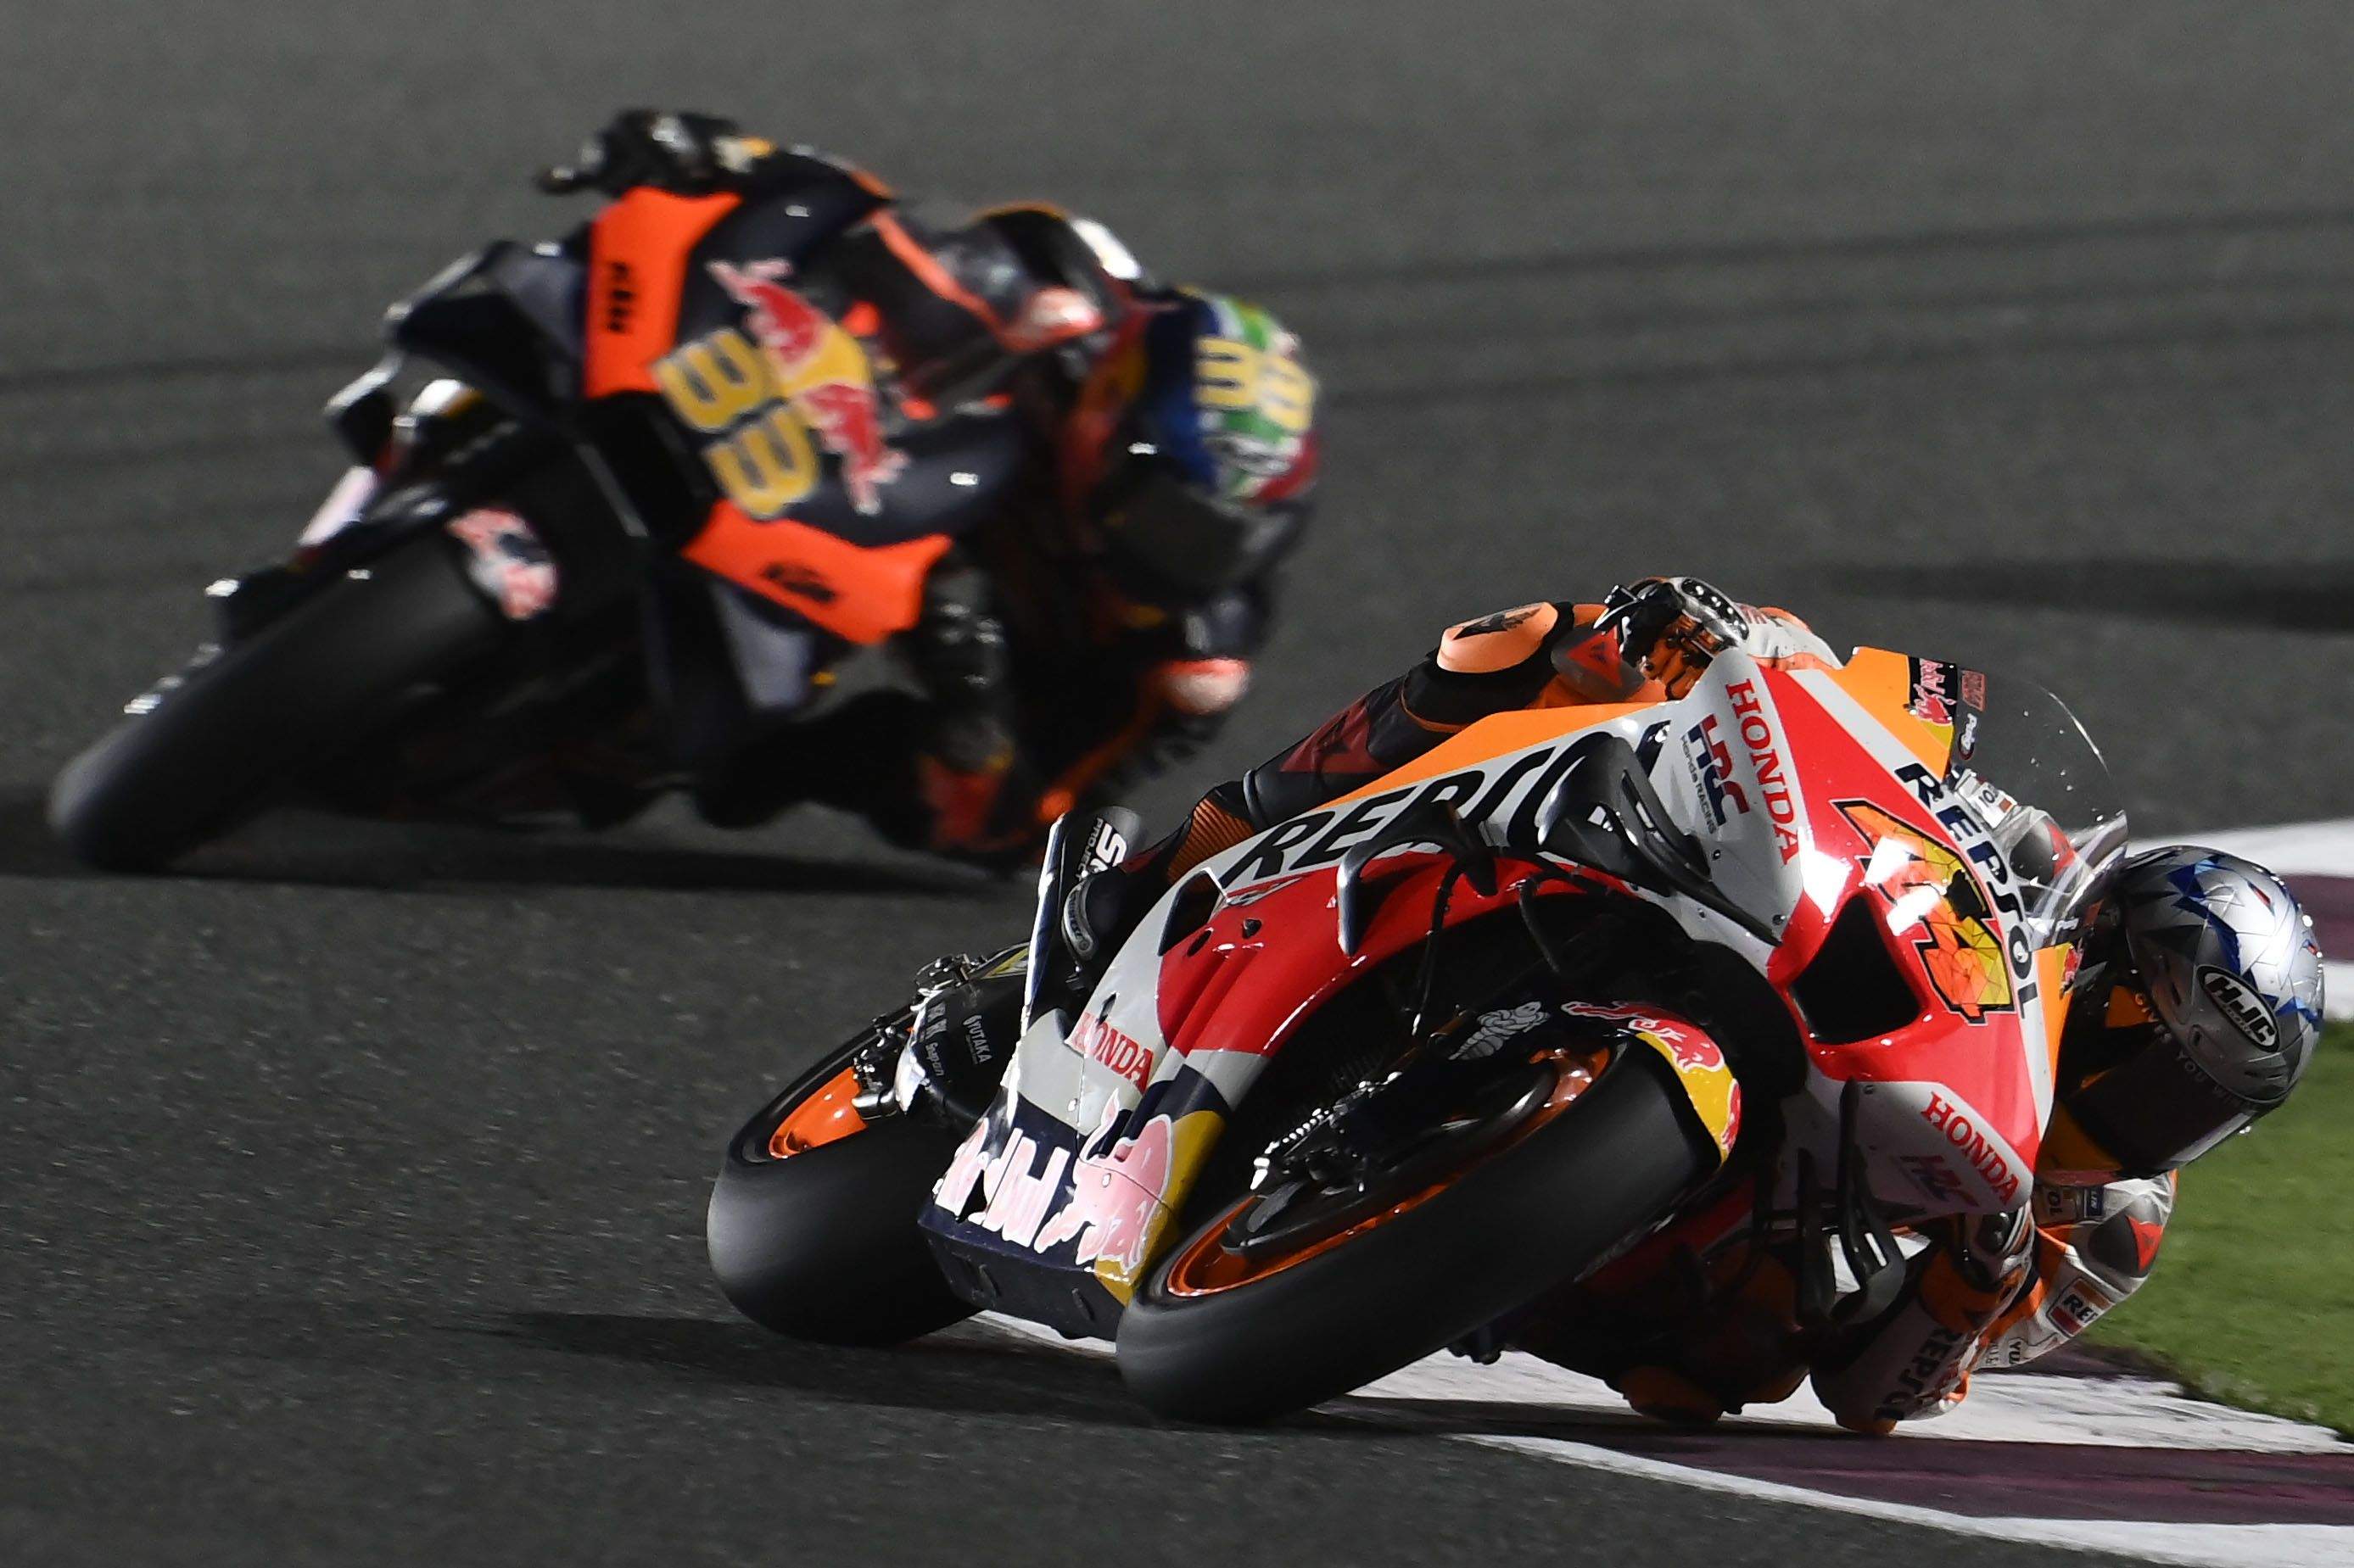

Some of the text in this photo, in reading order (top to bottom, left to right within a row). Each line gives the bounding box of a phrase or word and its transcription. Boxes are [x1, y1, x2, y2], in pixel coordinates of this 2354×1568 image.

[1687, 713, 1750, 827] HRC
[1725, 678, 1802, 866] HONDA
[1894, 762, 2038, 1020] REPSOL
[966, 1020, 992, 1063] YUTAKA
[2206, 975, 2277, 1044] HJC
[1920, 1091, 2021, 1205] HONDA
